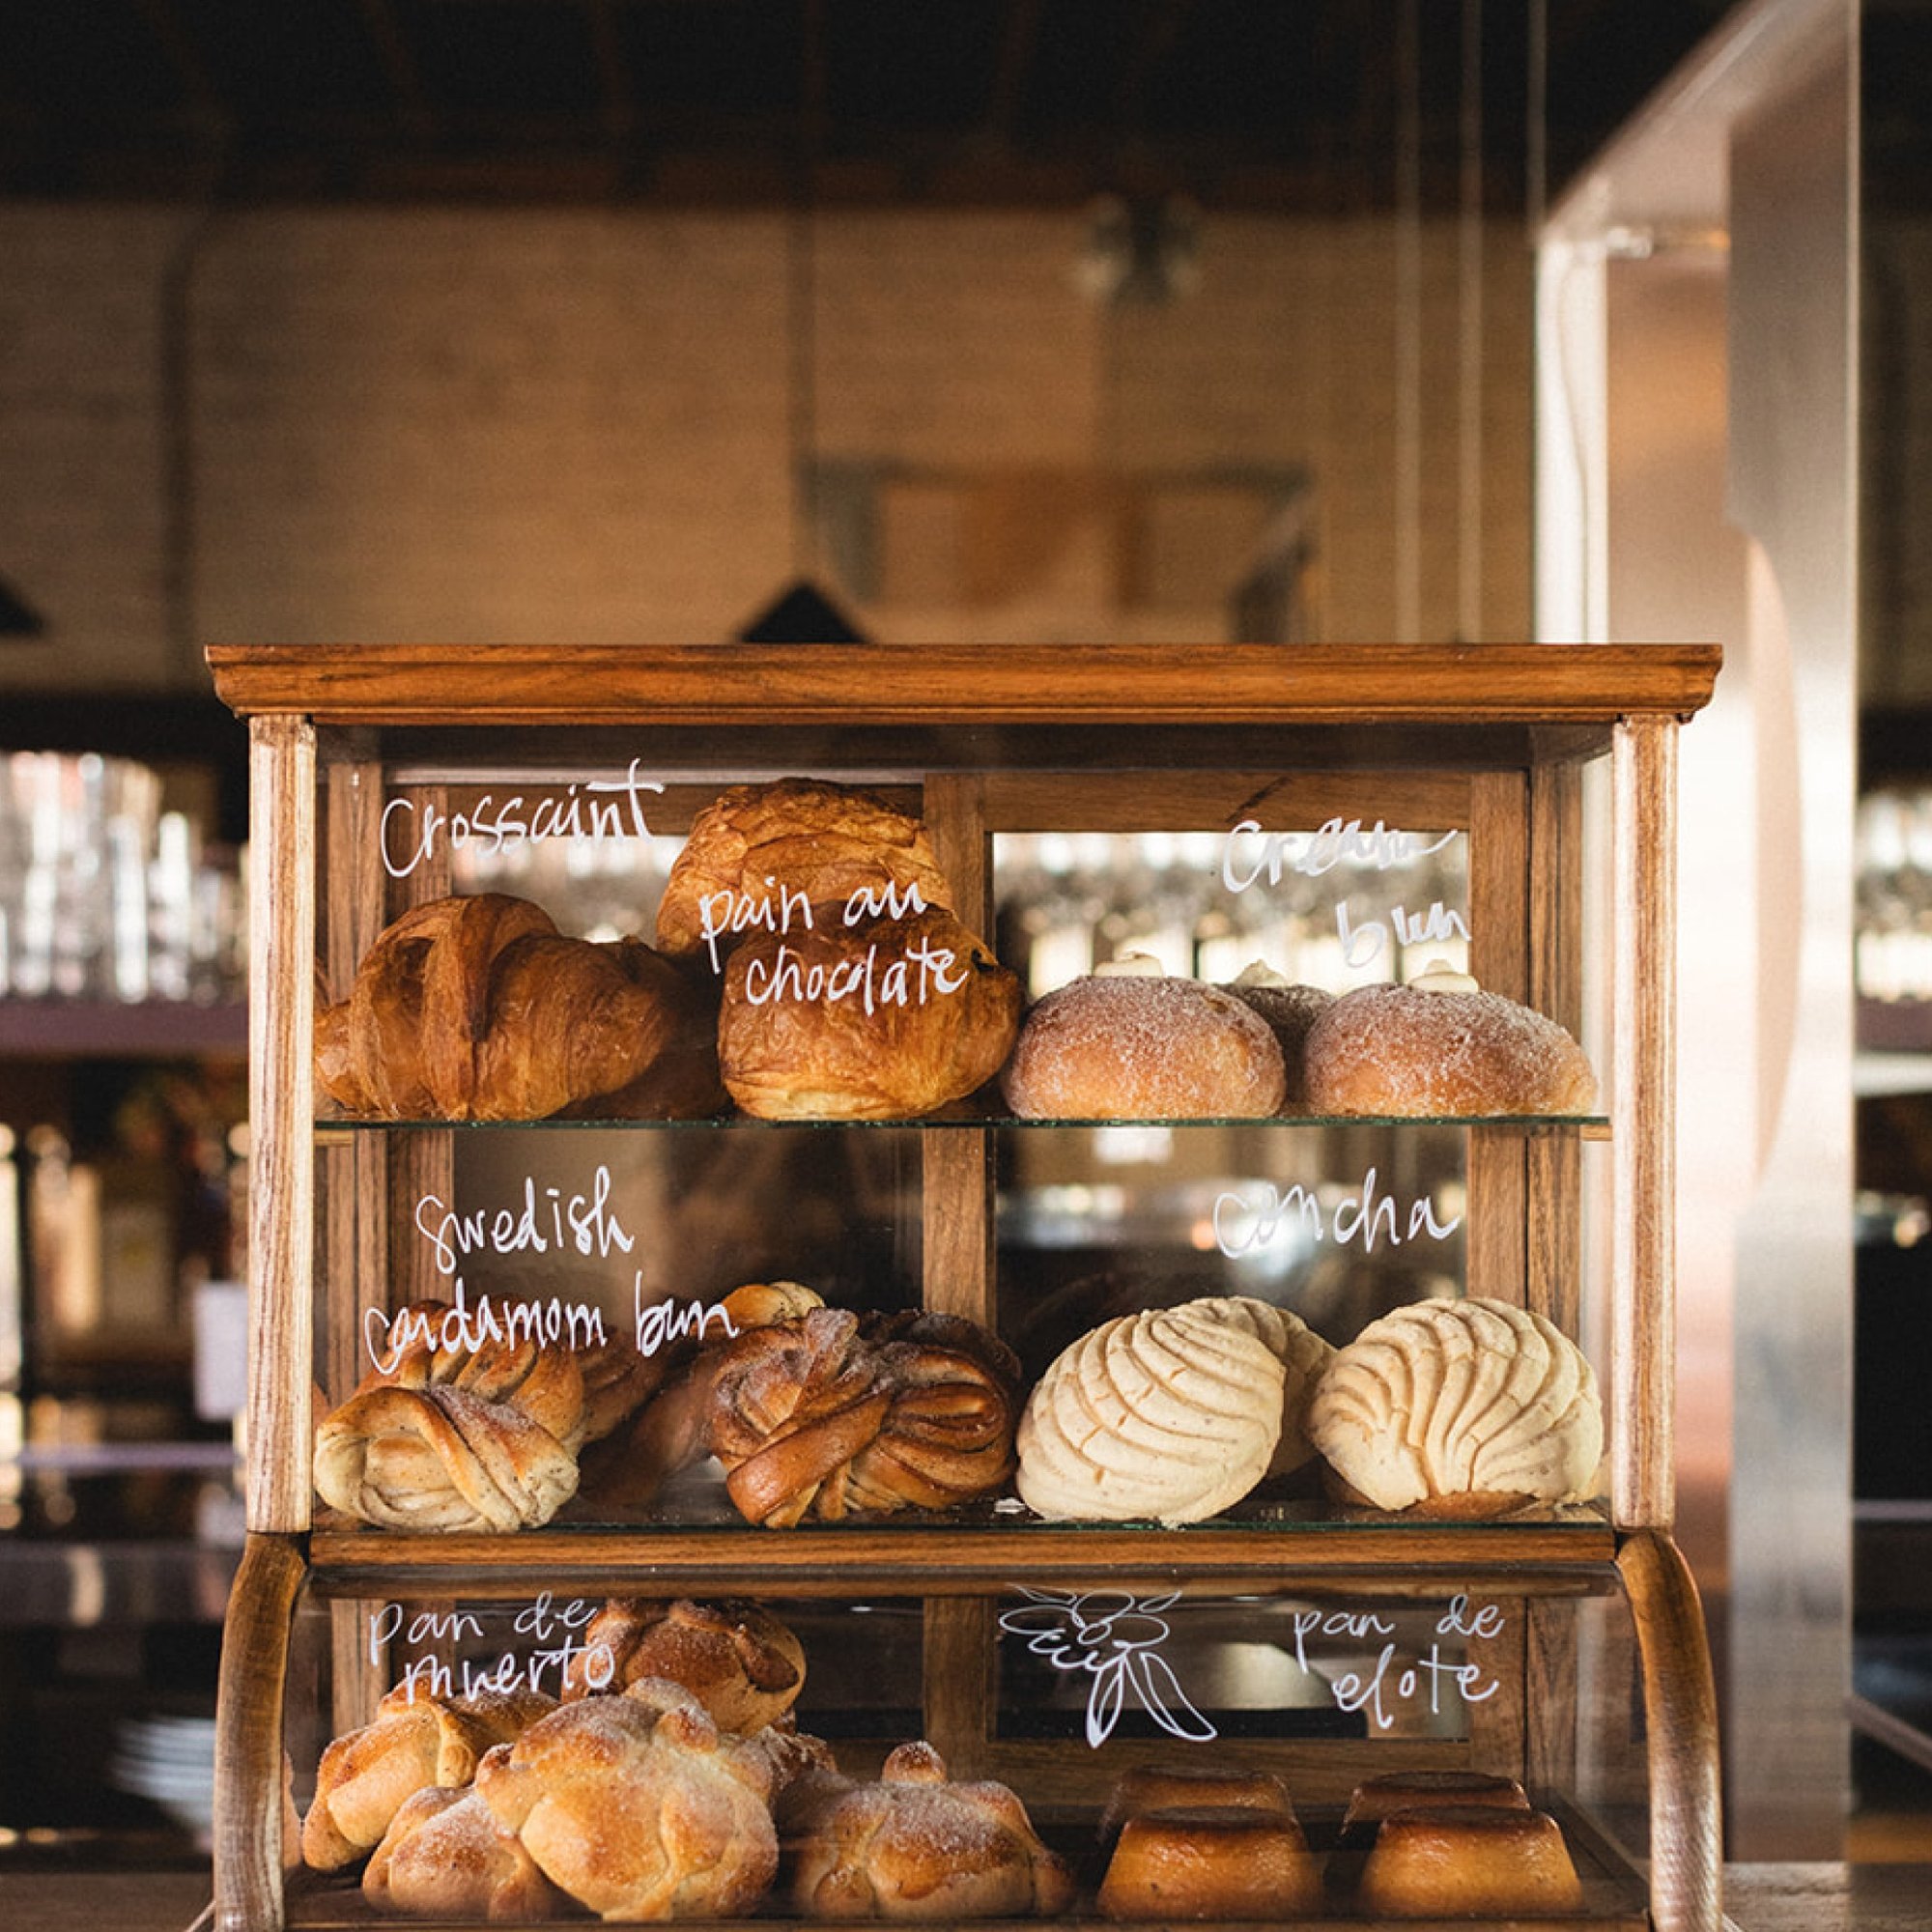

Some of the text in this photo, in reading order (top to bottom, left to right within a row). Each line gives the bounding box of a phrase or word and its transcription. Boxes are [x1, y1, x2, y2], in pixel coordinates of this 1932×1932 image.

[697, 876, 926, 974] pain au
[1335, 901, 1472, 968] bun
[744, 934, 968, 1016] chocolate
[633, 1269, 741, 1357] bun
[368, 1590, 598, 1667] pan de
[1293, 1595, 1505, 1674] pan de
[403, 1635, 615, 1705] muerto
[1332, 1644, 1499, 1729] elote
